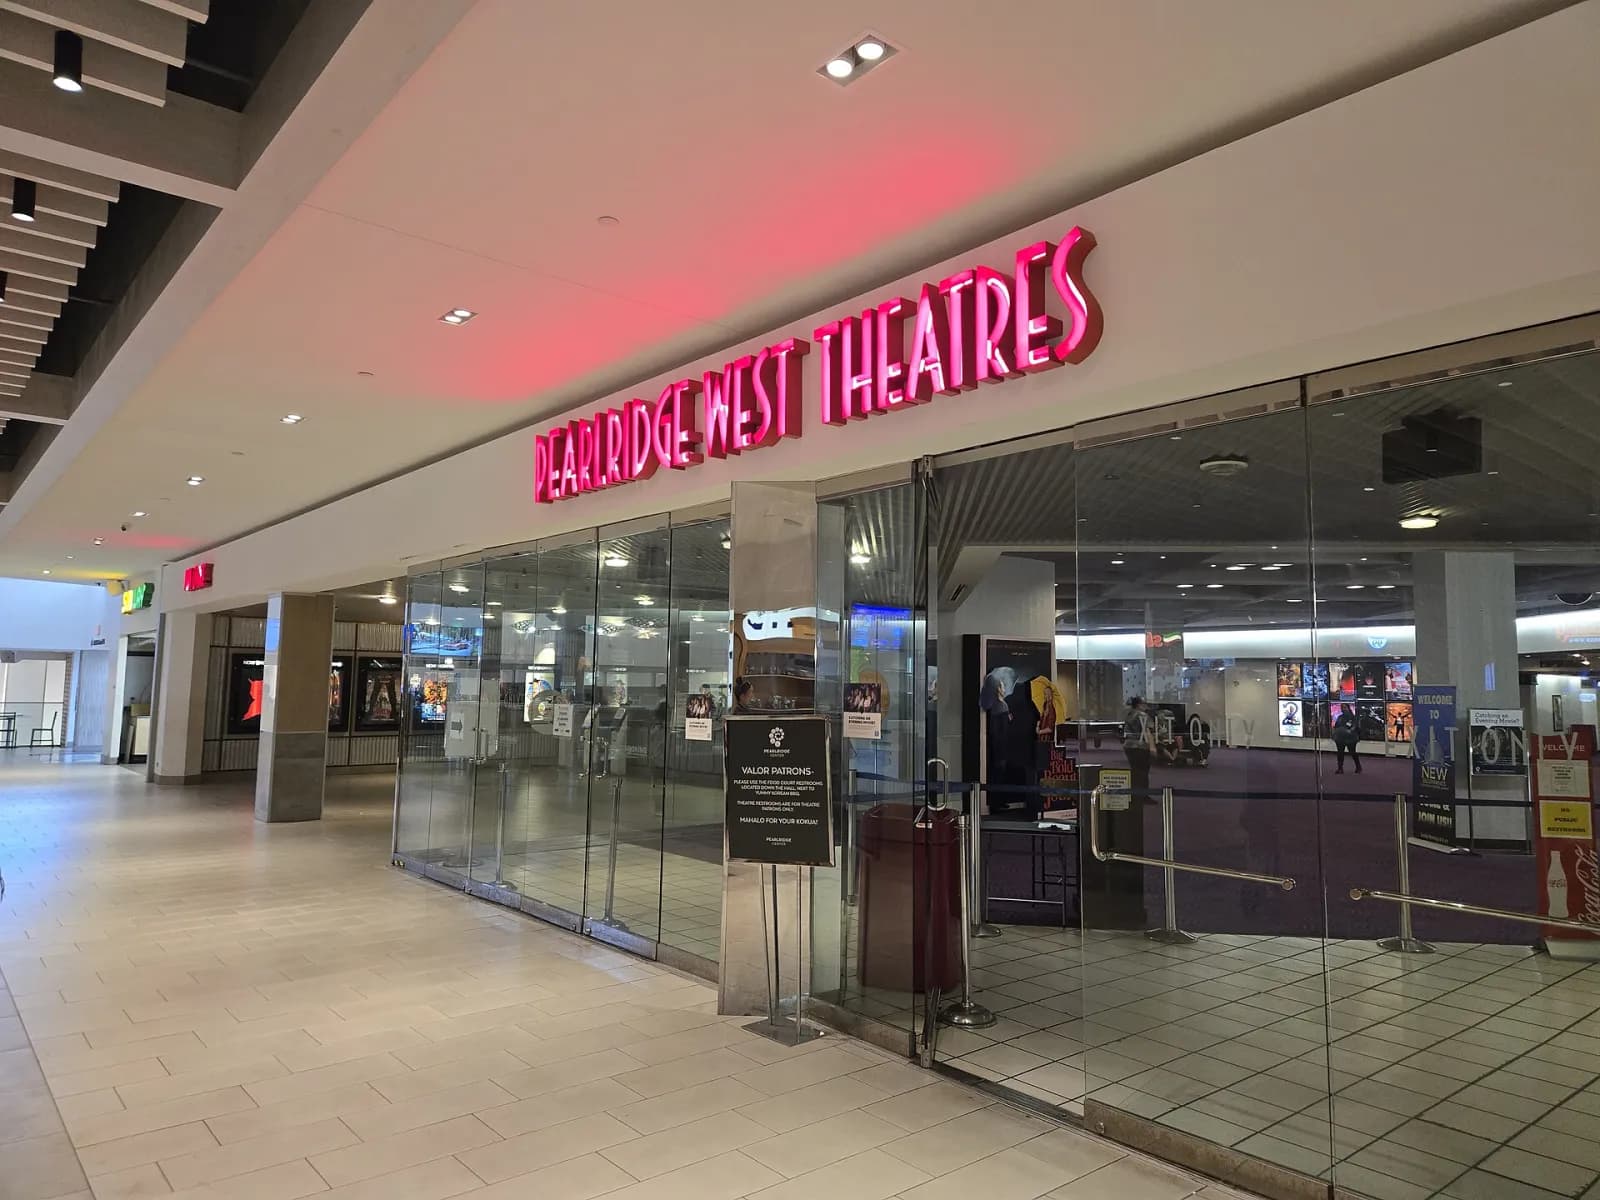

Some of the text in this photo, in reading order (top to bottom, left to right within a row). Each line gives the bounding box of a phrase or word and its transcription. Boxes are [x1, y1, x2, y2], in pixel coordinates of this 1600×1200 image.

[536, 225, 1104, 503] PEARLRIDGE WEST THEATRES
[1417, 694, 1453, 705] WELCOME
[1429, 709, 1440, 720] TO
[741, 766, 770, 775] VALOR
[1421, 766, 1448, 781] NEW
[740, 816, 764, 824] MAHALO
